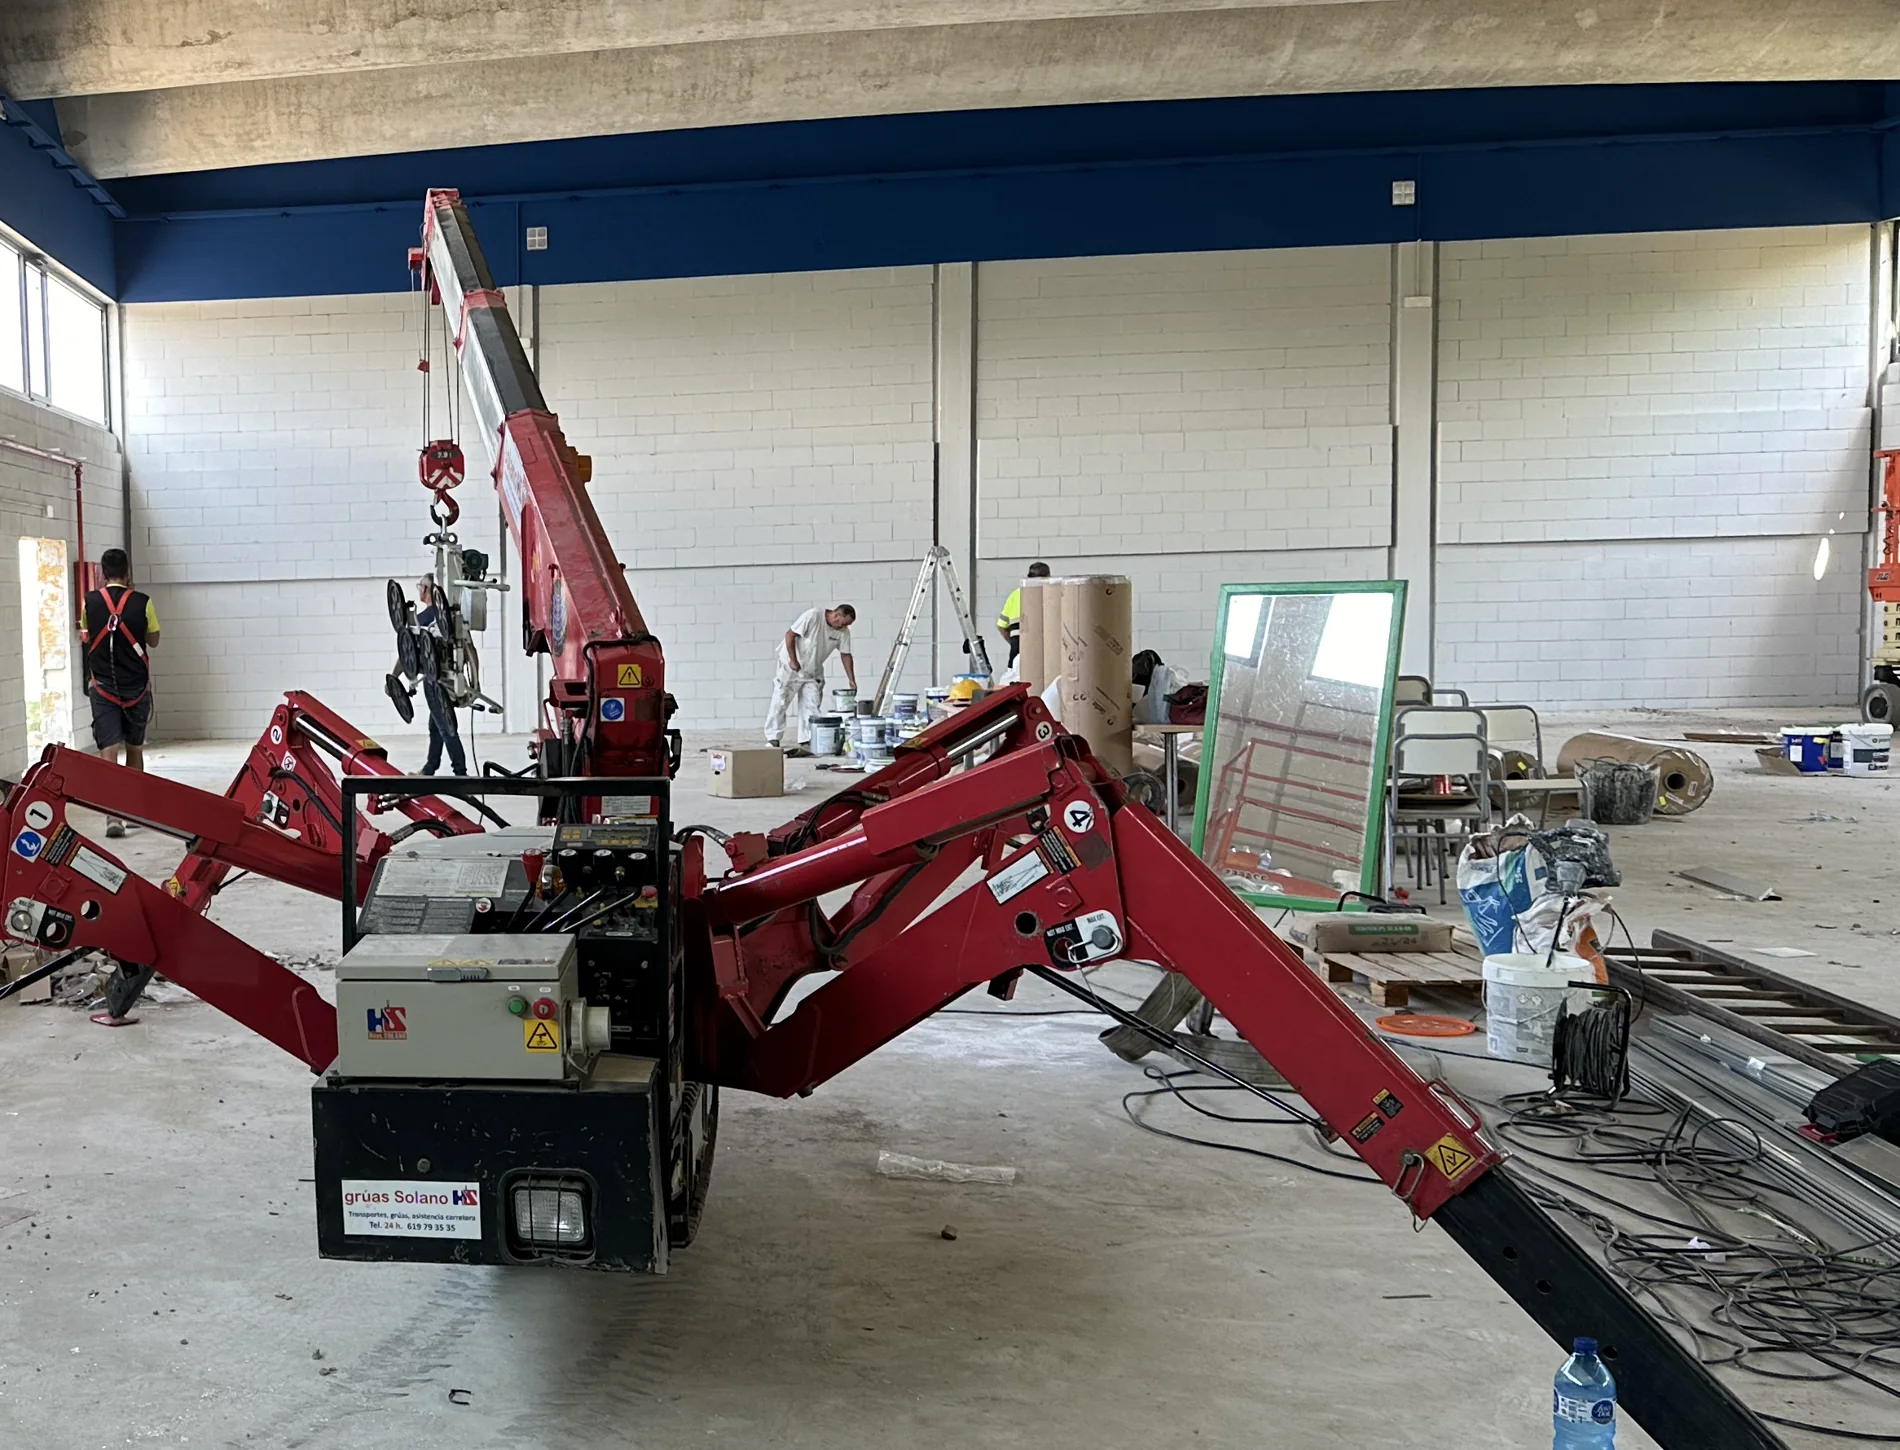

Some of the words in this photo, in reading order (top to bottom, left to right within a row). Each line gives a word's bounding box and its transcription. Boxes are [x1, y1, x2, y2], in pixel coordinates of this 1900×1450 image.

[272, 728, 281, 742] 2
[1038, 724, 1050, 739] 3
[29, 808, 48, 821] 1
[1070, 809, 1091, 828] 4
[345, 1190, 390, 1205] grúas
[394, 1190, 448, 1204] Solano
[349, 1211, 389, 1219] Transportes,
[385, 1222, 394, 1230] 24
[423, 1223, 433, 1231] 79
[435, 1223, 444, 1231] 35
[446, 1224, 456, 1232] 35
